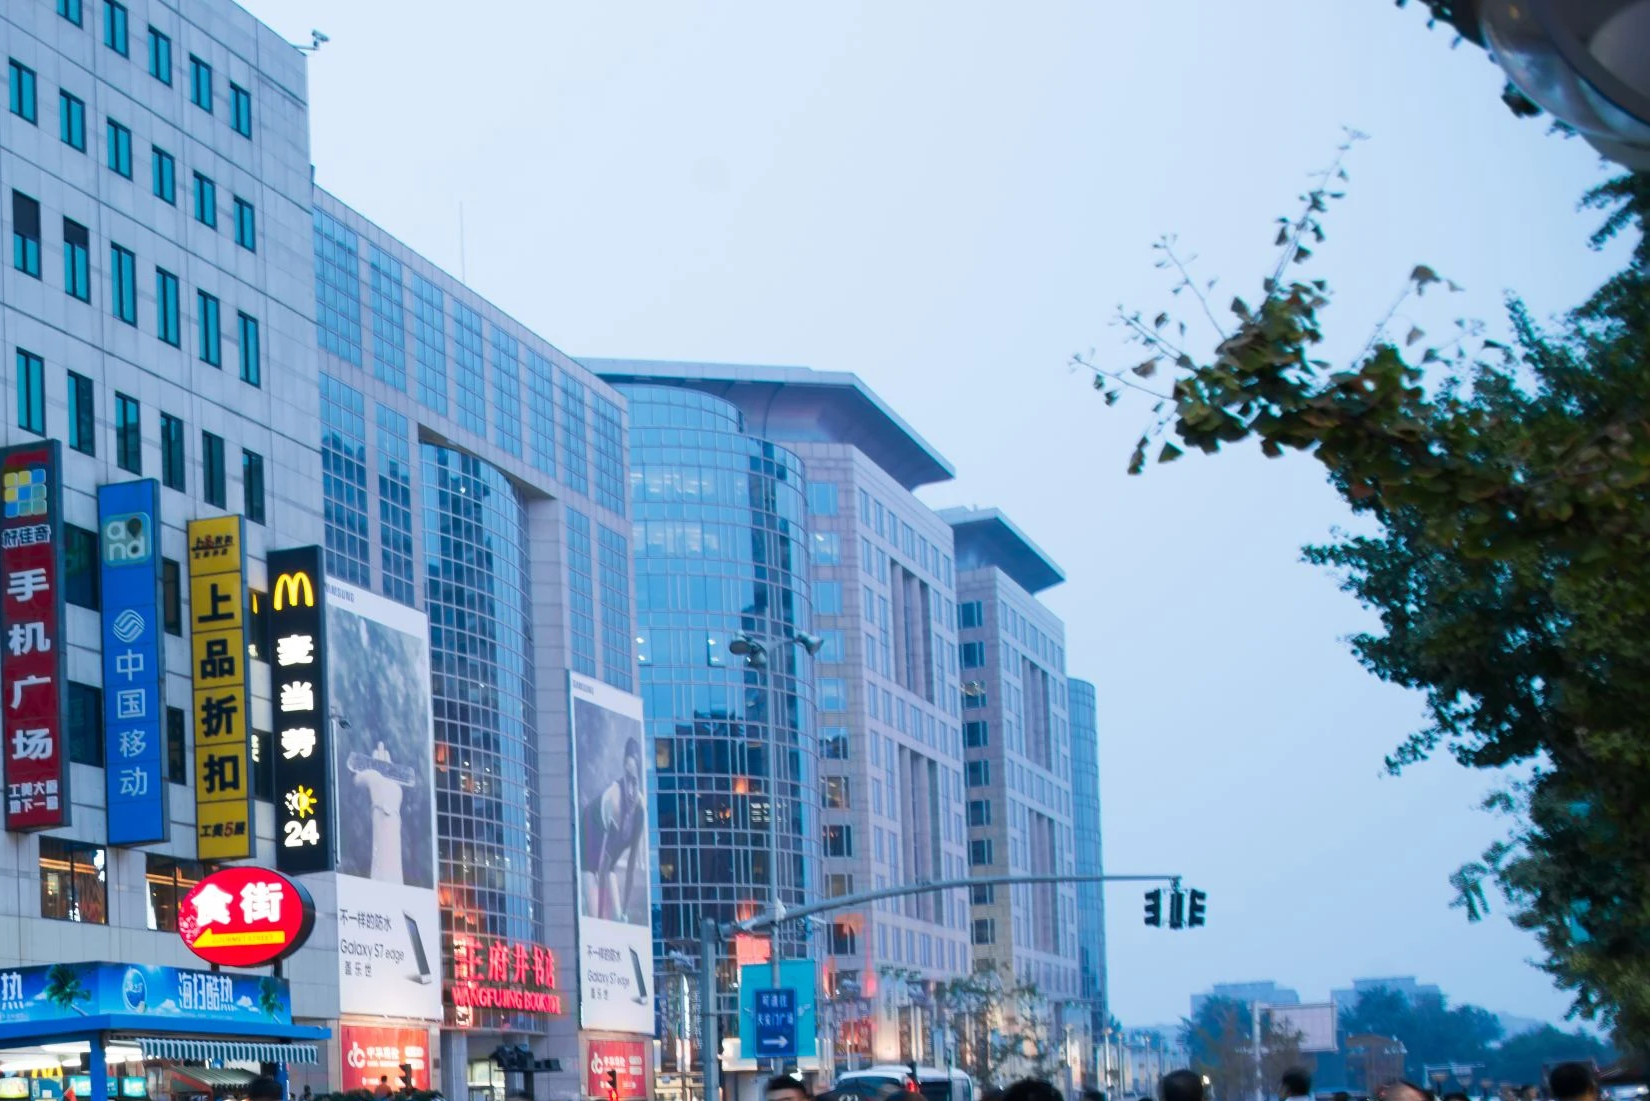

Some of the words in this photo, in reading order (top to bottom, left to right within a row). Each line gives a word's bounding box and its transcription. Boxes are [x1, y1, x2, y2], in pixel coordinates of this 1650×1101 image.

[7, 567, 53, 761] 手机广场
[198, 583, 241, 794] 上品折扣
[276, 634, 316, 760] 麦当劳
[116, 648, 148, 797] 中国移动
[284, 818, 320, 848] 24
[190, 881, 284, 927] 食街
[340, 908, 392, 932] 不一样的防水
[341, 938, 373, 961] Galaxy
[374, 942, 384, 959] S7
[385, 948, 405, 965] edge
[178, 972, 235, 1012] 海扫酷热
